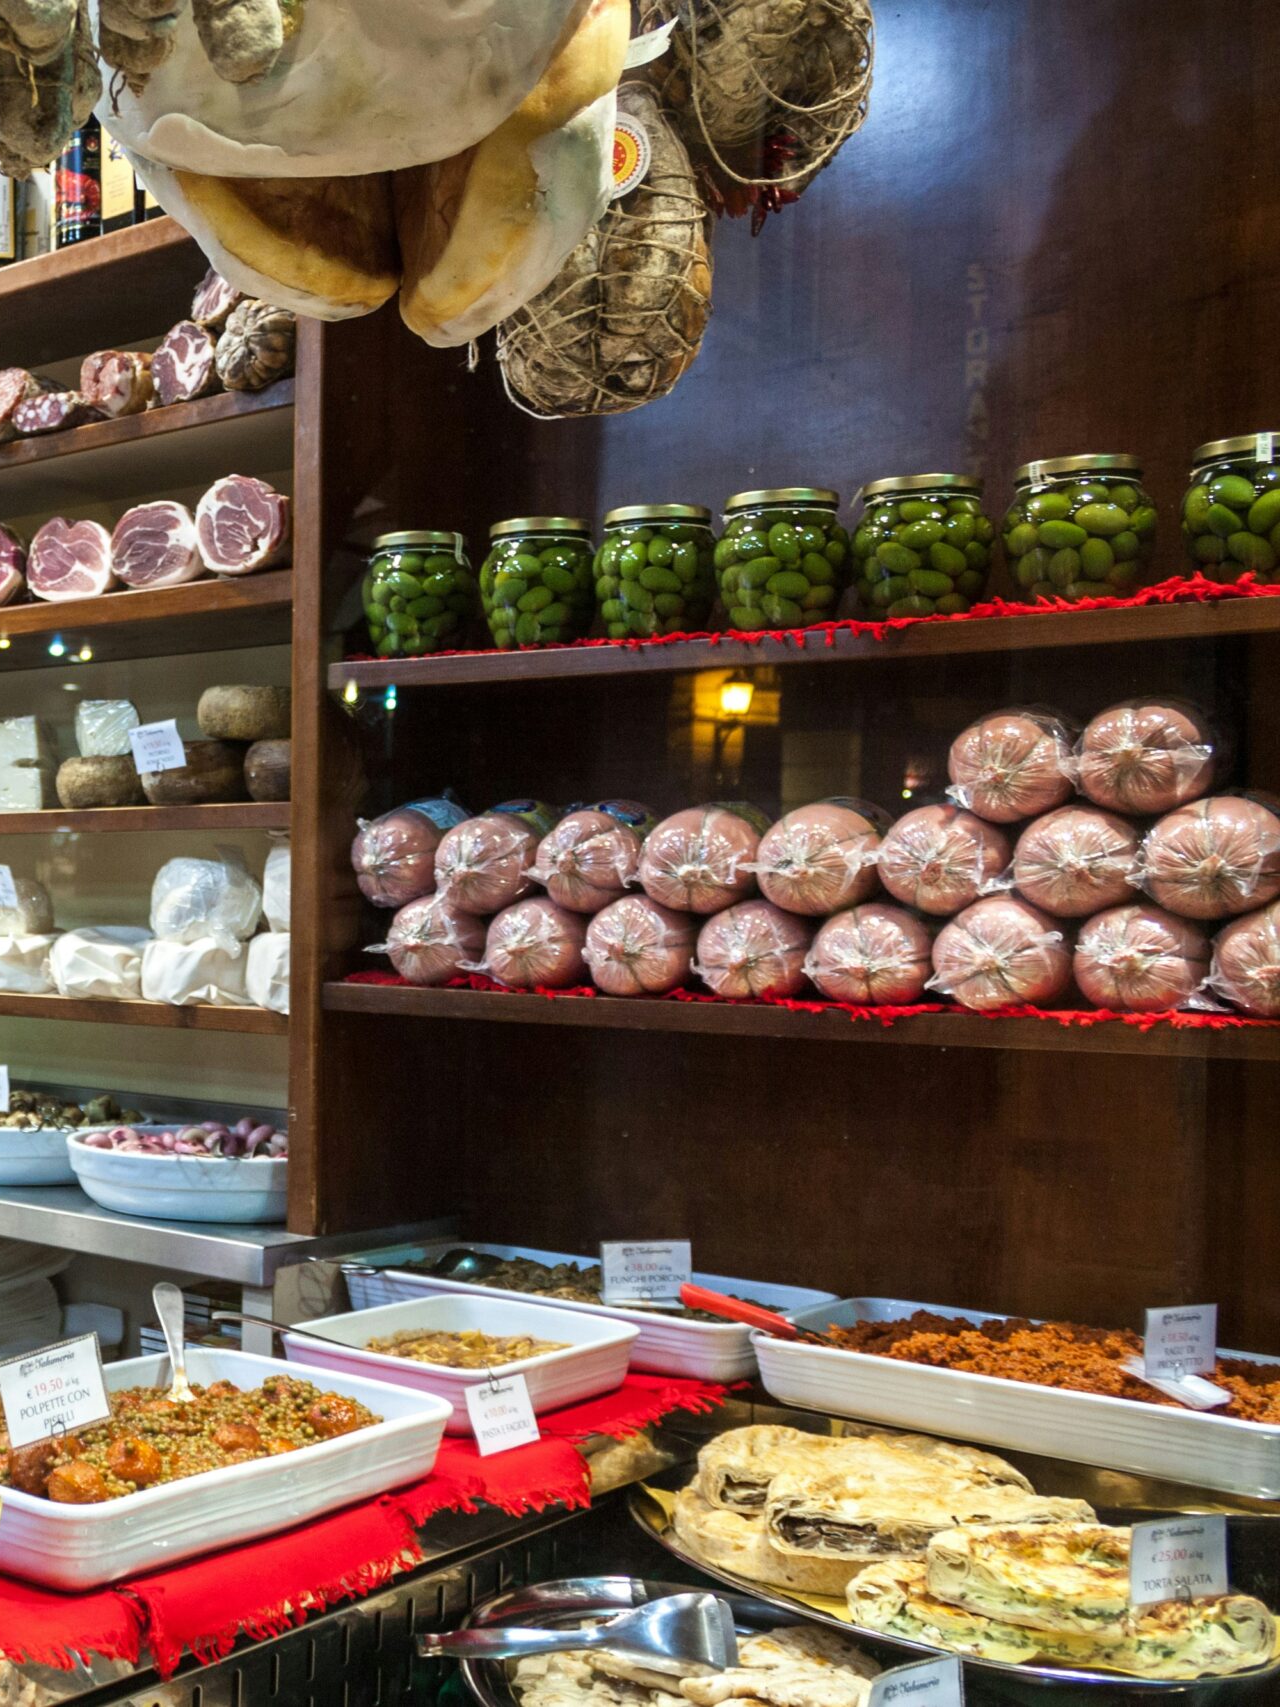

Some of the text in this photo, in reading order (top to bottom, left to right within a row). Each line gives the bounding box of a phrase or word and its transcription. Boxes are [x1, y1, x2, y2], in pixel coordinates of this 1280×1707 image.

[34, 1377, 63, 1397] 19,50
[20, 1388, 91, 1420] POLPETTE CON
[1143, 1574, 1213, 1591] TORTA SALATA
